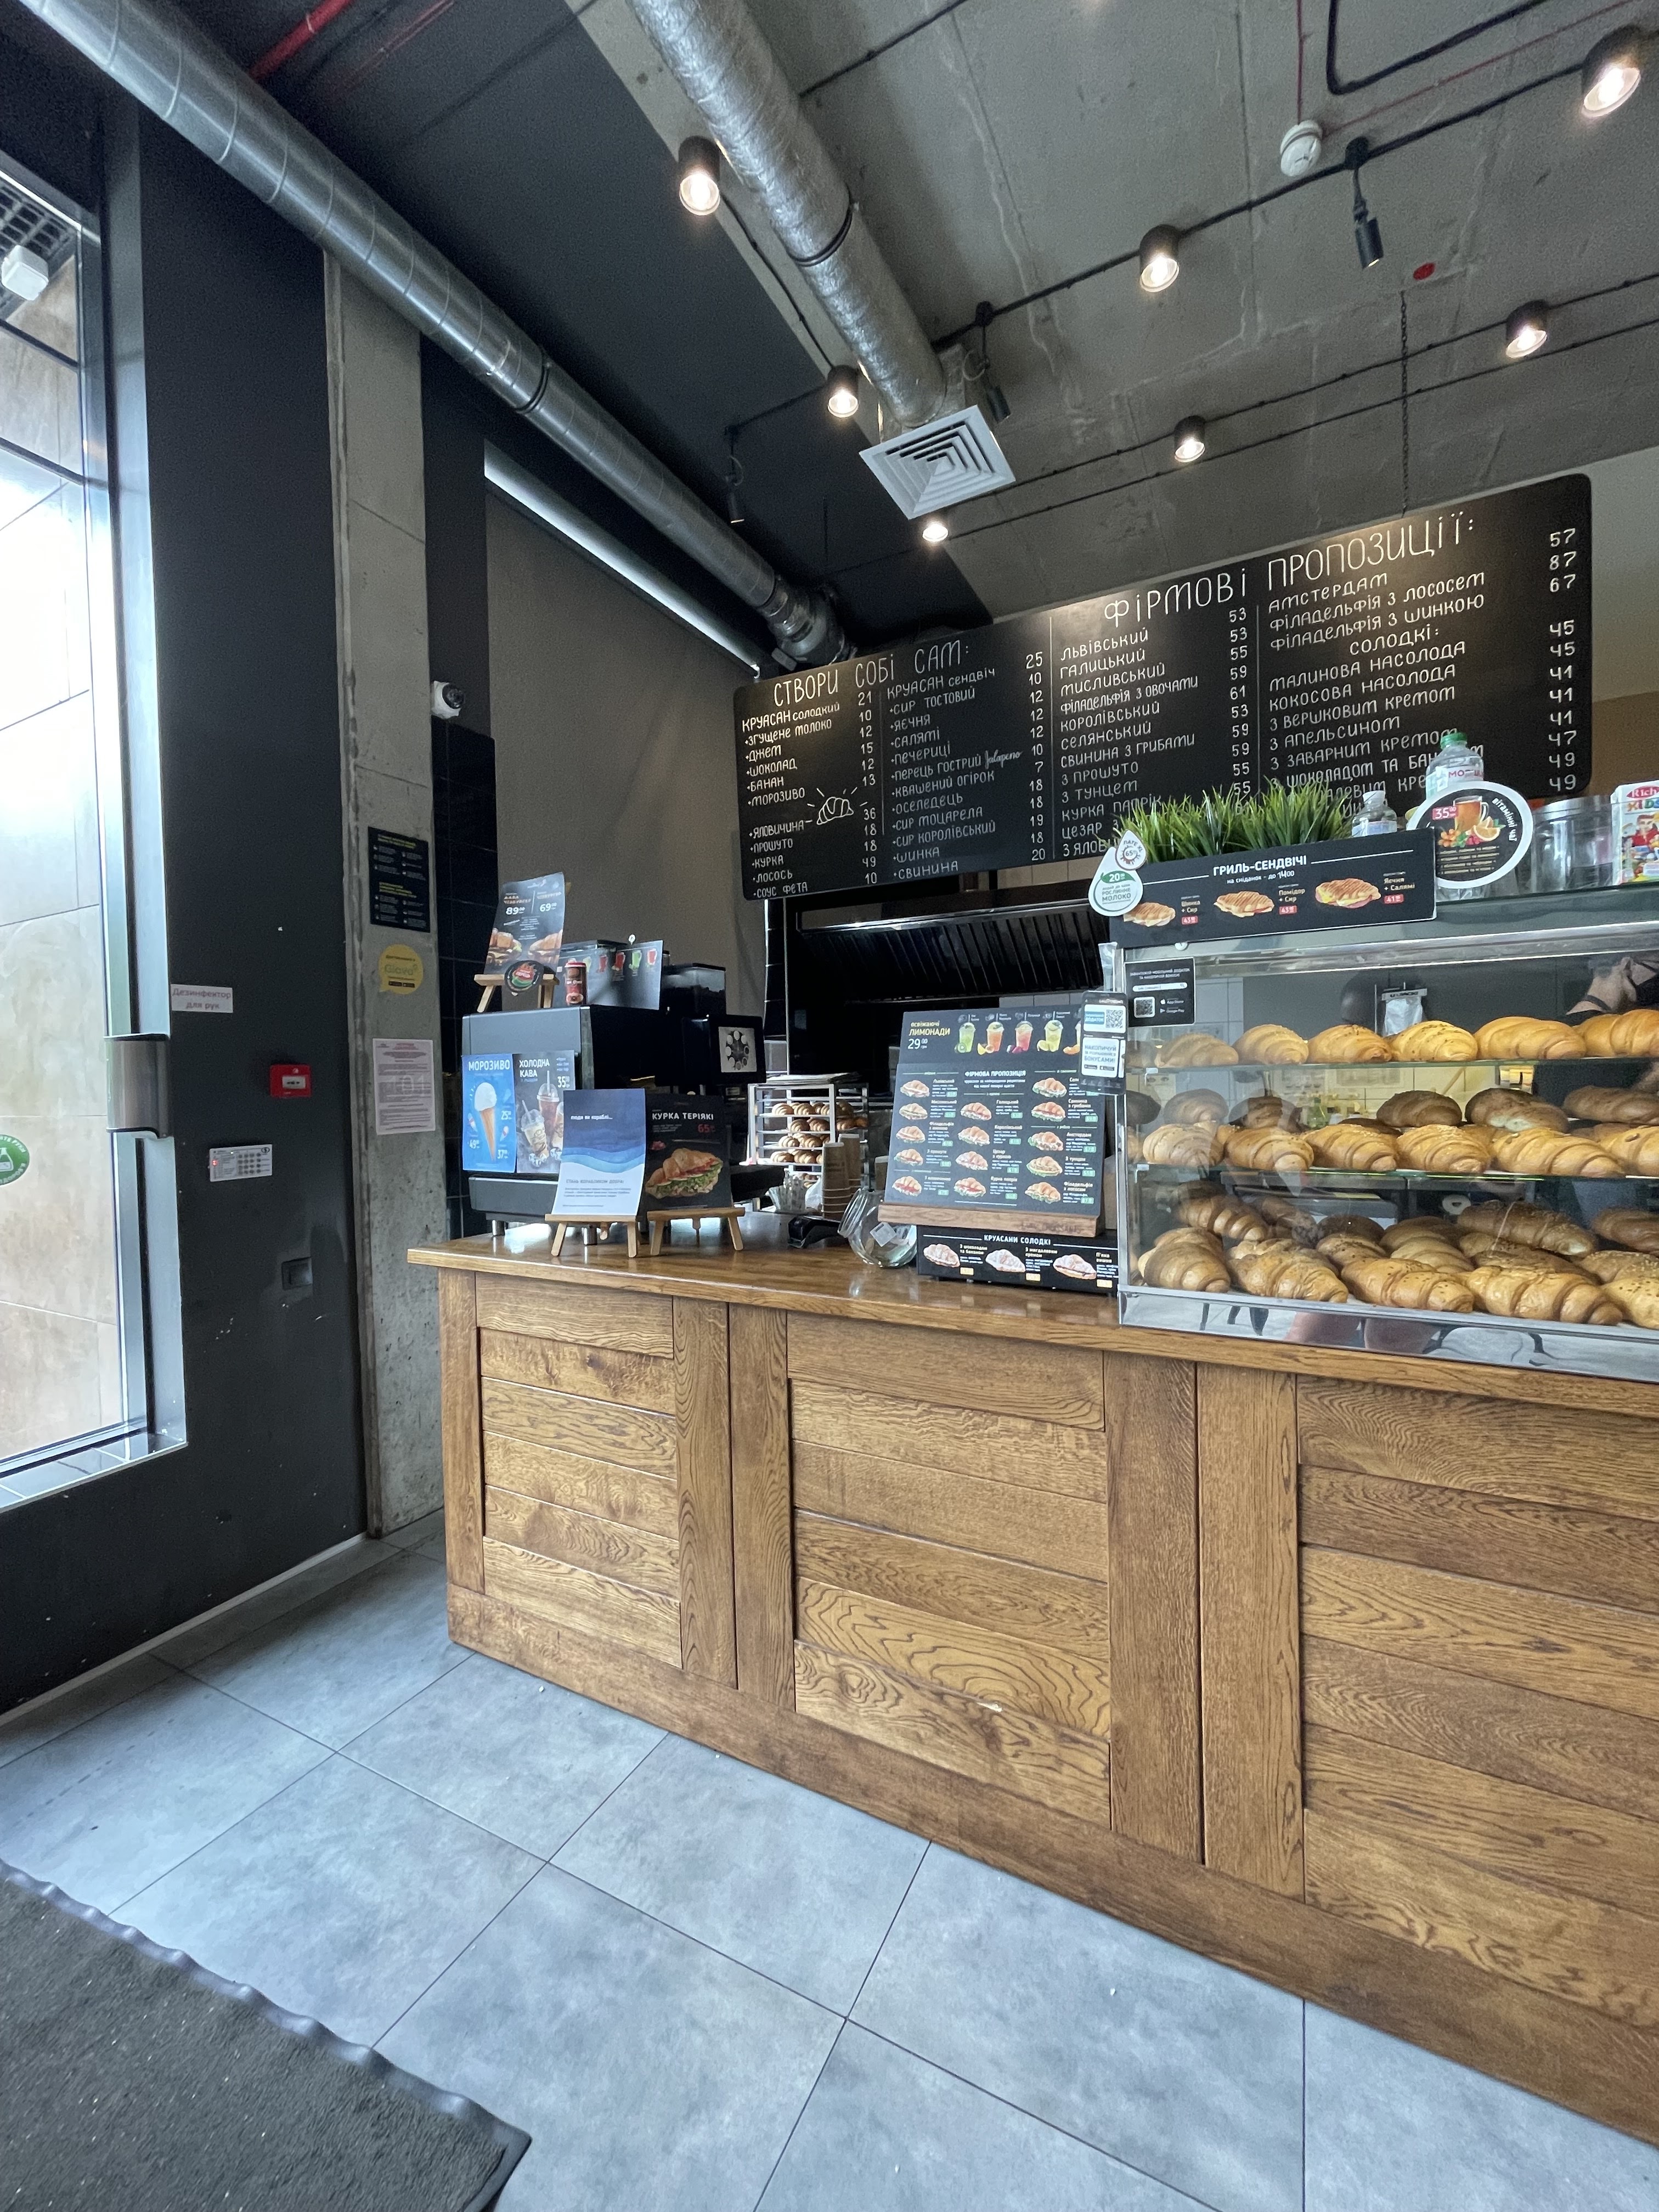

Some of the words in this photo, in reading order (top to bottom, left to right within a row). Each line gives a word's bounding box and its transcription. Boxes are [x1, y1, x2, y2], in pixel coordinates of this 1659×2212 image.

[1550, 528, 1576, 547] 57
[1550, 551, 1576, 570] 87
[1550, 574, 1576, 592] 67
[1104, 567, 1246, 628] ФІРМОВІ
[1229, 607, 1246, 623] 53
[1230, 627, 1248, 642] 53
[1231, 645, 1248, 660] 55
[1370, 641, 1465, 672] НАСОЛОДА
[1550, 620, 1575, 637] 45
[774, 669, 838, 707] СТВОРИ
[856, 654, 894, 687] СОБІ
[888, 675, 944, 699] КРУАСАН
[1026, 652, 1042, 669] 25
[1231, 665, 1247, 680] 59
[1269, 684, 1352, 712] КОКОСОВА
[1362, 664, 1455, 693] НАСОЛОДА
[1550, 641, 1575, 656] 45
[1550, 665, 1572, 680] 41
[894, 700, 915, 714] СИР
[924, 686, 975, 709] ТОСТОВИЙ
[1029, 672, 1041, 686] 10
[1030, 690, 1043, 703] 12
[1230, 685, 1246, 700] 61
[1550, 687, 1573, 702] 41
[742, 710, 791, 732] КРУАСАН
[793, 702, 839, 721] солодкий
[858, 691, 871, 706] 21
[859, 710, 871, 722] 10
[1030, 708, 1043, 721] 12
[1232, 704, 1248, 718] 53
[1550, 710, 1572, 725] 41
[860, 725, 872, 738] 12
[1030, 725, 1043, 738] 12
[1061, 747, 1118, 768] СВИНИНА
[1232, 723, 1249, 738] 59
[1381, 759, 1398, 773] ТА
[1549, 730, 1576, 747] 47
[749, 758, 797, 777] ШОКОЛАД
[861, 742, 873, 754] 15
[938, 754, 981, 774] ГОСТРИЙ
[1031, 744, 1042, 756] 10
[1074, 761, 1138, 784] ПРОШУТО
[1232, 742, 1249, 757] 59
[1549, 753, 1575, 768] 49
[751, 776, 785, 792] БАНАН
[862, 758, 874, 770] 12
[957, 770, 994, 787] ОГІРОК
[1035, 761, 1043, 773] 7
[1233, 763, 1249, 776] 55
[752, 788, 805, 806] МОРОЗИВО
[862, 774, 875, 786] 13
[1029, 779, 1042, 791] 18
[1549, 774, 1576, 791] 49
[1062, 804, 1104, 822] КУРКА
[1233, 781, 1251, 795] 55
[864, 808, 876, 820] 36
[896, 818, 914, 831] СИР
[1030, 796, 1042, 809] 18
[754, 838, 793, 853] ПРОШУТО
[865, 825, 877, 836] 18
[896, 834, 914, 847] СИР
[1030, 814, 1043, 826] 19
[1031, 832, 1043, 843] 18
[755, 855, 783, 868] КУРКА
[865, 840, 877, 851] 18
[756, 870, 792, 883] ЛОСОСЬ
[862, 856, 876, 867] 49
[899, 861, 958, 879] СВИНИНА
[1031, 848, 1045, 860] 20
[1213, 855, 1307, 877] ГРИЛЬ-СЕНДВІЧІ
[757, 887, 776, 898] СОУС
[865, 872, 877, 884] 10
[1102, 893, 1131, 902] МОЛОКО
[909, 1028, 950, 1036] ЛИМОНАДИ
[469, 1059, 510, 1071] МОРОЗИВО
[519, 1058, 550, 1068] ХОЛОДНА
[984, 1235, 1018, 1244] КРУАСАНИ
[1020, 1237, 1051, 1245] СОЛОДКІ
